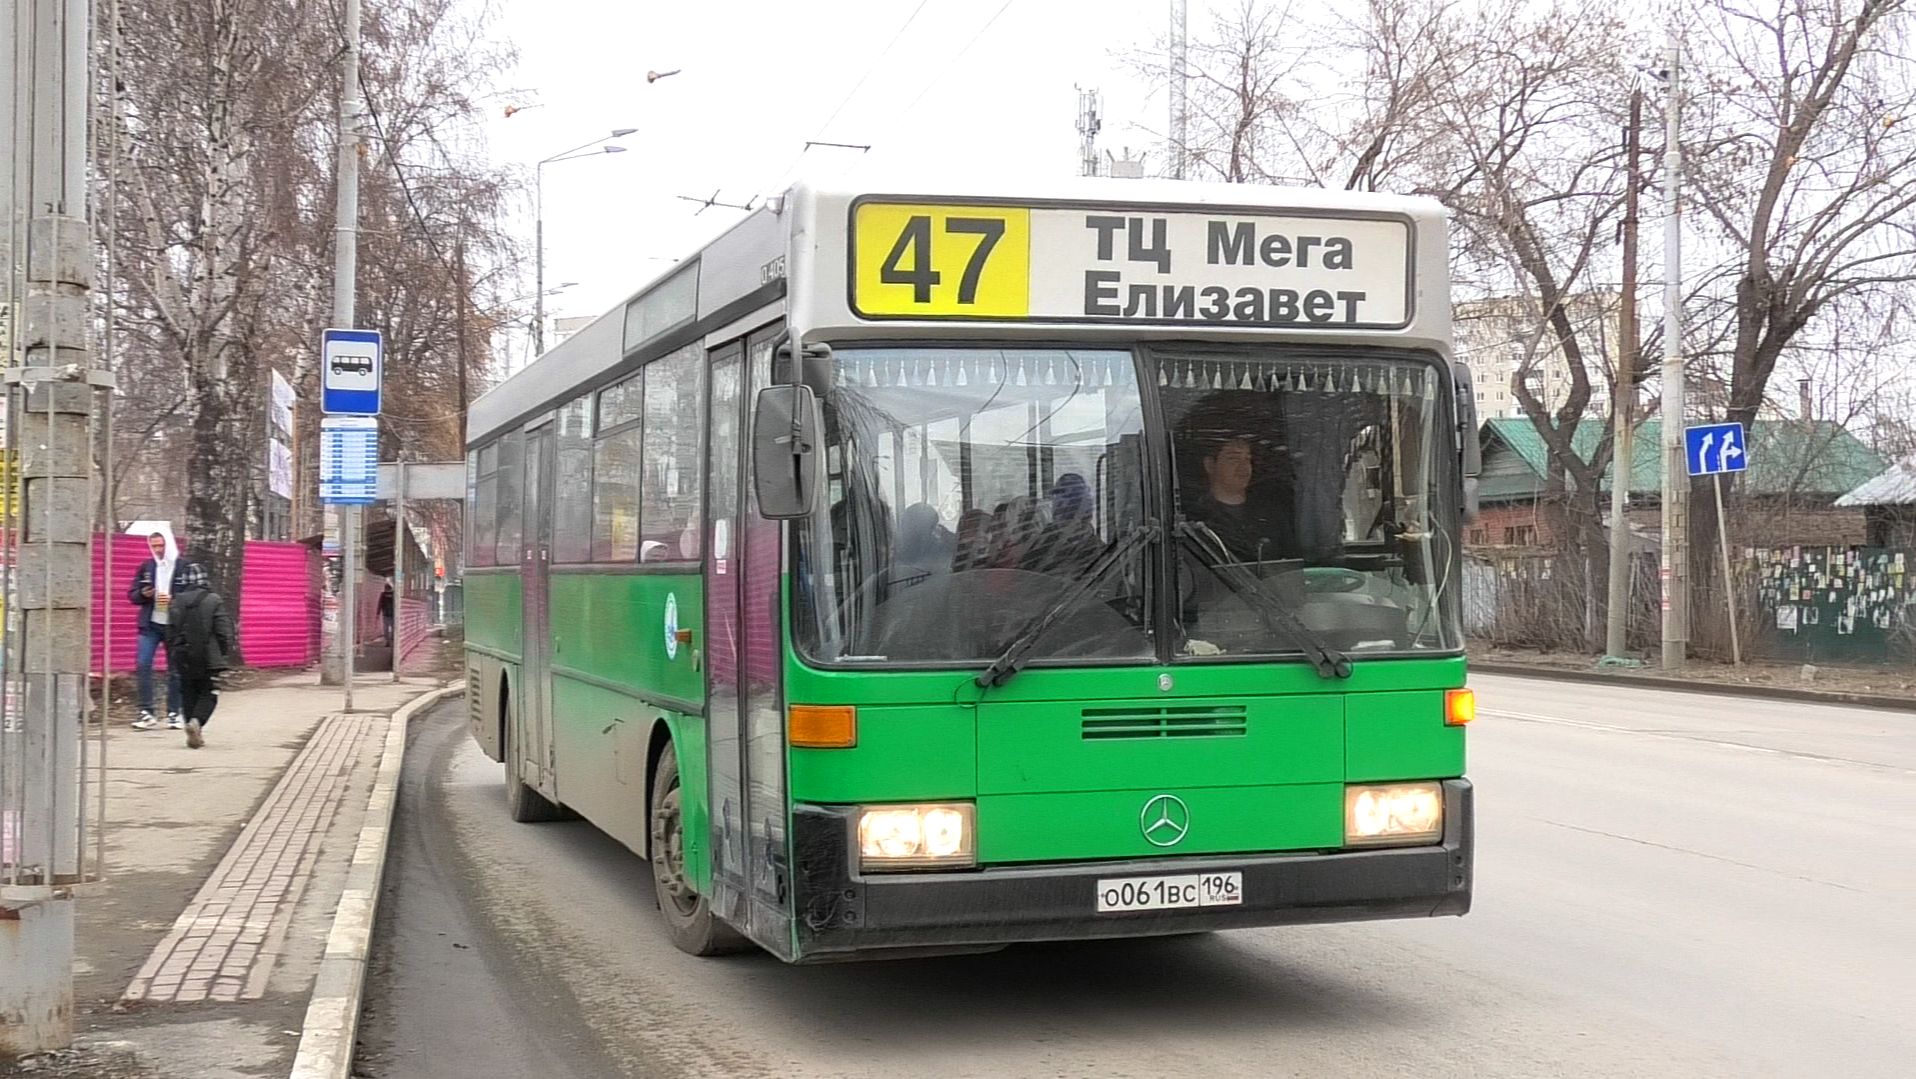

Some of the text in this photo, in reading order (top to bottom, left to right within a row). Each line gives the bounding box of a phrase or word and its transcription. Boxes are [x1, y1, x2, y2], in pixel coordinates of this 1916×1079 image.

[880, 215, 1005, 304] 47
[1086, 215, 1353, 274] ТЦ Мега
[1084, 270, 1366, 323] Елизавет
[1202, 875, 1235, 895] 196
